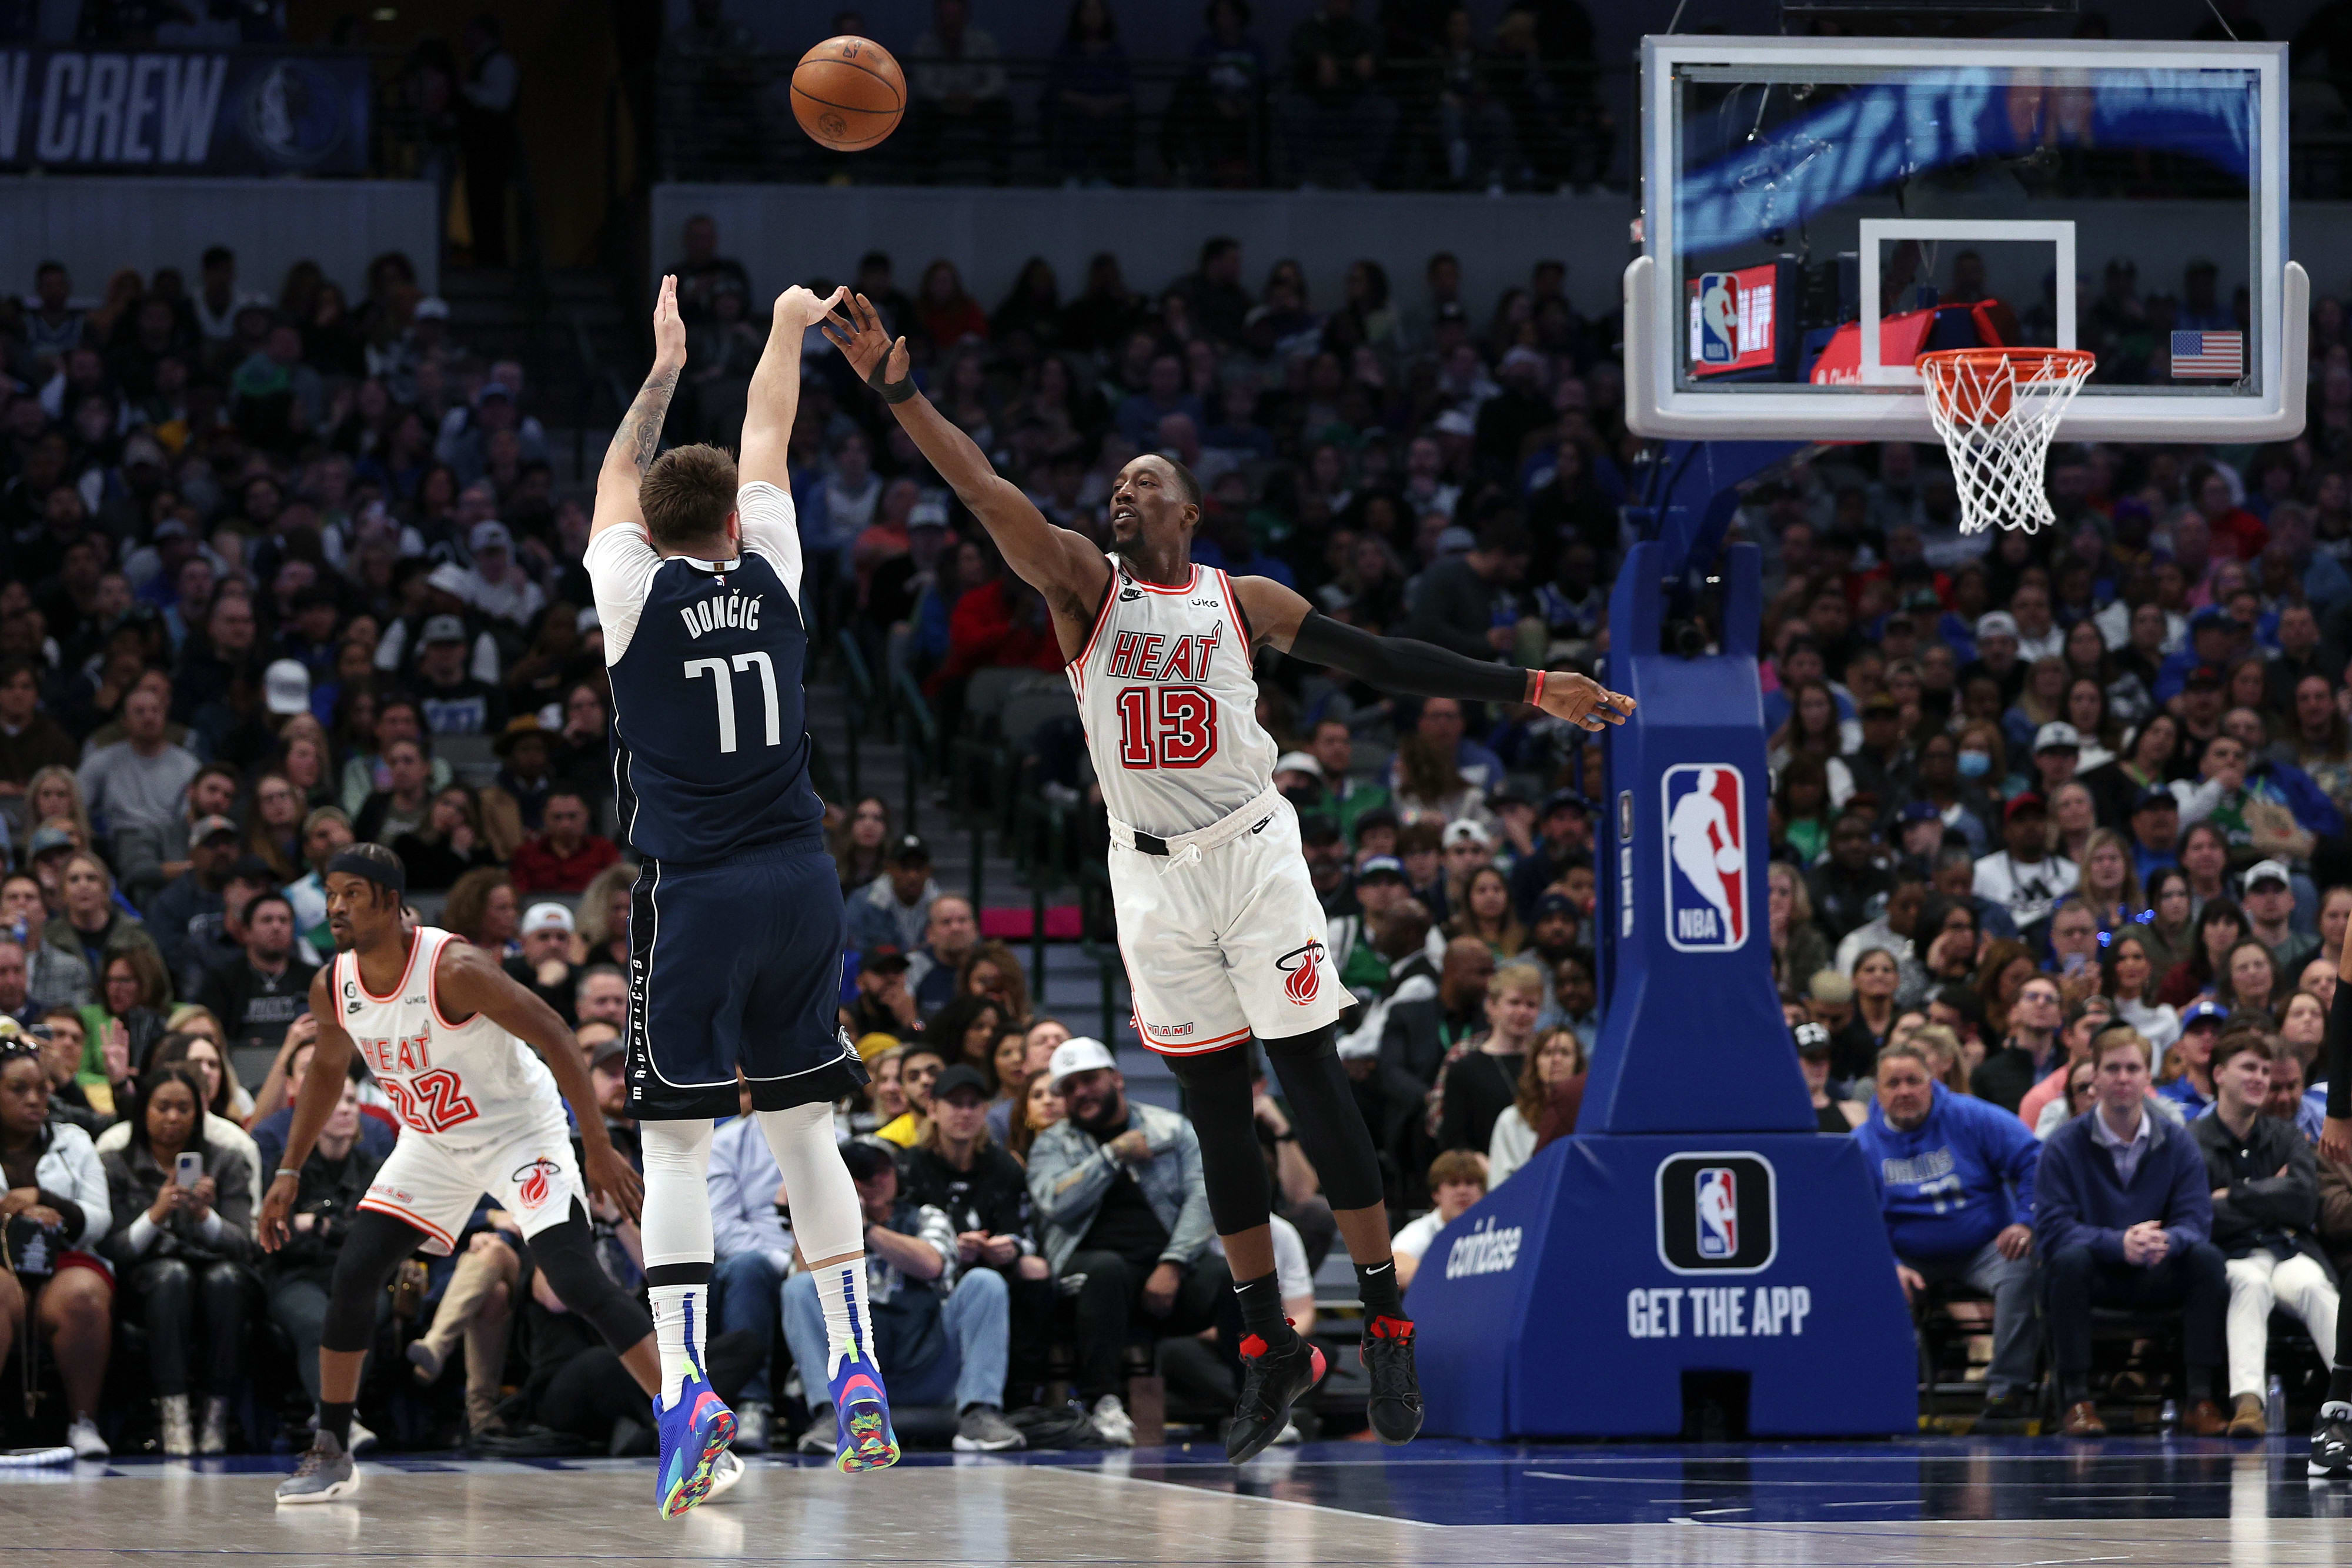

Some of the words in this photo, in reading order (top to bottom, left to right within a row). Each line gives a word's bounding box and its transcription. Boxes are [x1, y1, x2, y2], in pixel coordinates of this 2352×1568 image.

[36, 52, 229, 163] CREW
[680, 589, 763, 640] DONČIĆ
[1107, 619, 1222, 682] HEAT
[684, 651, 780, 753] 77
[1116, 686, 1218, 770] 13
[1678, 908, 1718, 939] NBA
[358, 1020, 432, 1074] HEAT
[1146, 1022, 1193, 1037] MIAMI
[376, 1068, 479, 1134] 22
[1446, 1215, 1522, 1281] coinbase
[1627, 1288, 1684, 1338] GET
[1688, 1287, 1747, 1337] THE
[1751, 1286, 1811, 1336] APP
